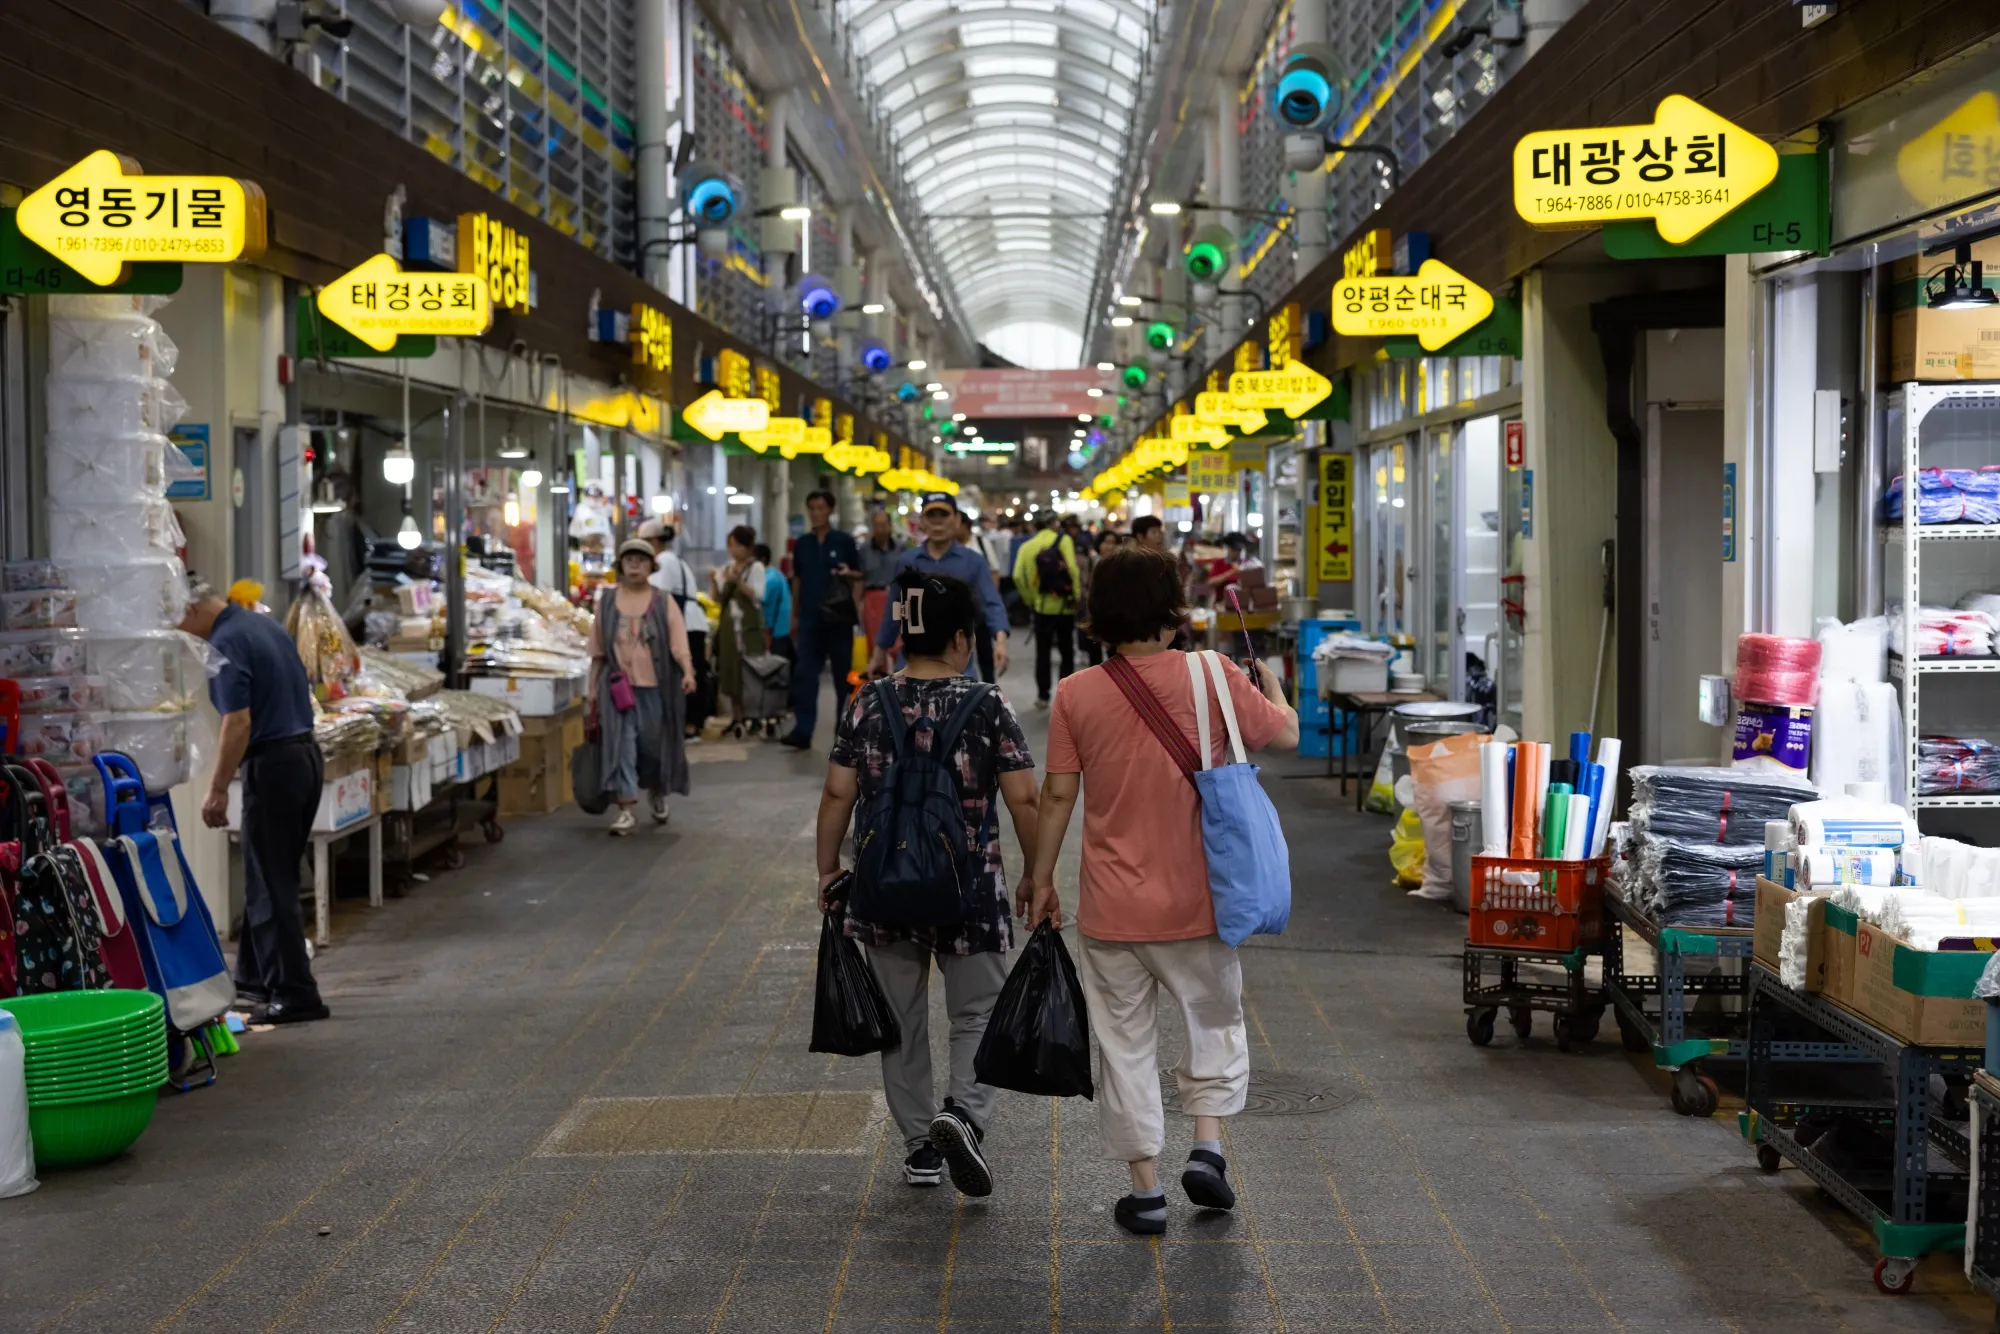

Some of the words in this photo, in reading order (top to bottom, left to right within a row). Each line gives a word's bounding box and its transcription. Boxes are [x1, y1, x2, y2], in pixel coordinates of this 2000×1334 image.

[1532, 133, 1727, 187] 대광상회
[55, 186, 226, 229] 영동기물
[1535, 195, 1613, 214] T.964-7886
[1625, 187, 1731, 209] 010-4758-3641
[56, 237, 123, 252] T.961-7396
[132, 238, 226, 253] 010-2479-6853
[1752, 221, 1803, 246] 다-5
[5, 266, 63, 289] 다-45
[351, 282, 477, 312] 태경상회
[1343, 284, 1468, 313] 양평순대국
[1325, 458, 1346, 533] 출입구
